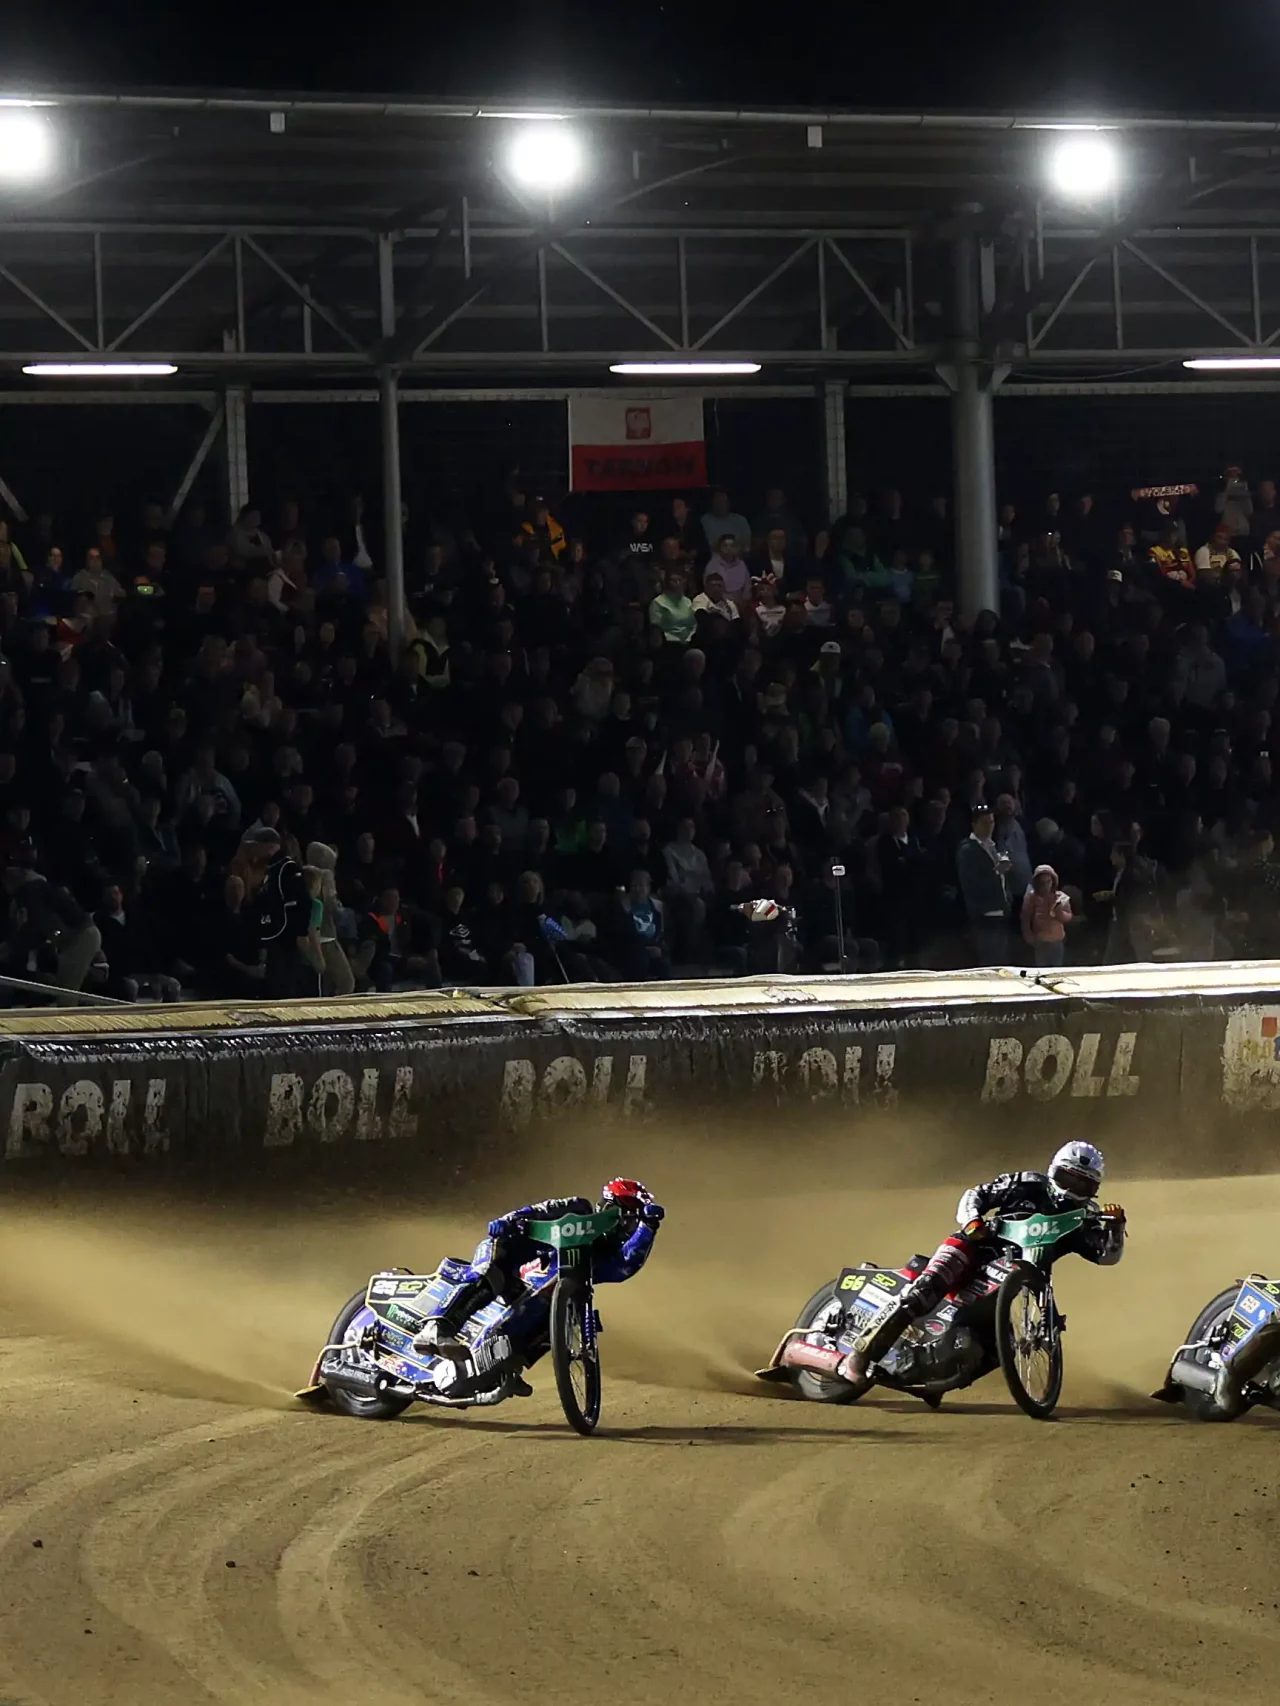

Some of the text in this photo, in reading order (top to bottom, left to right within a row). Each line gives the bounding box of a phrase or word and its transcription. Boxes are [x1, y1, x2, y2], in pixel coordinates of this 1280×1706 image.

[979, 1032, 1140, 1104] BOLL
[551, 1221, 595, 1240] BOLL
[840, 1274, 866, 1291] 66
[872, 1273, 897, 1288] SGP
